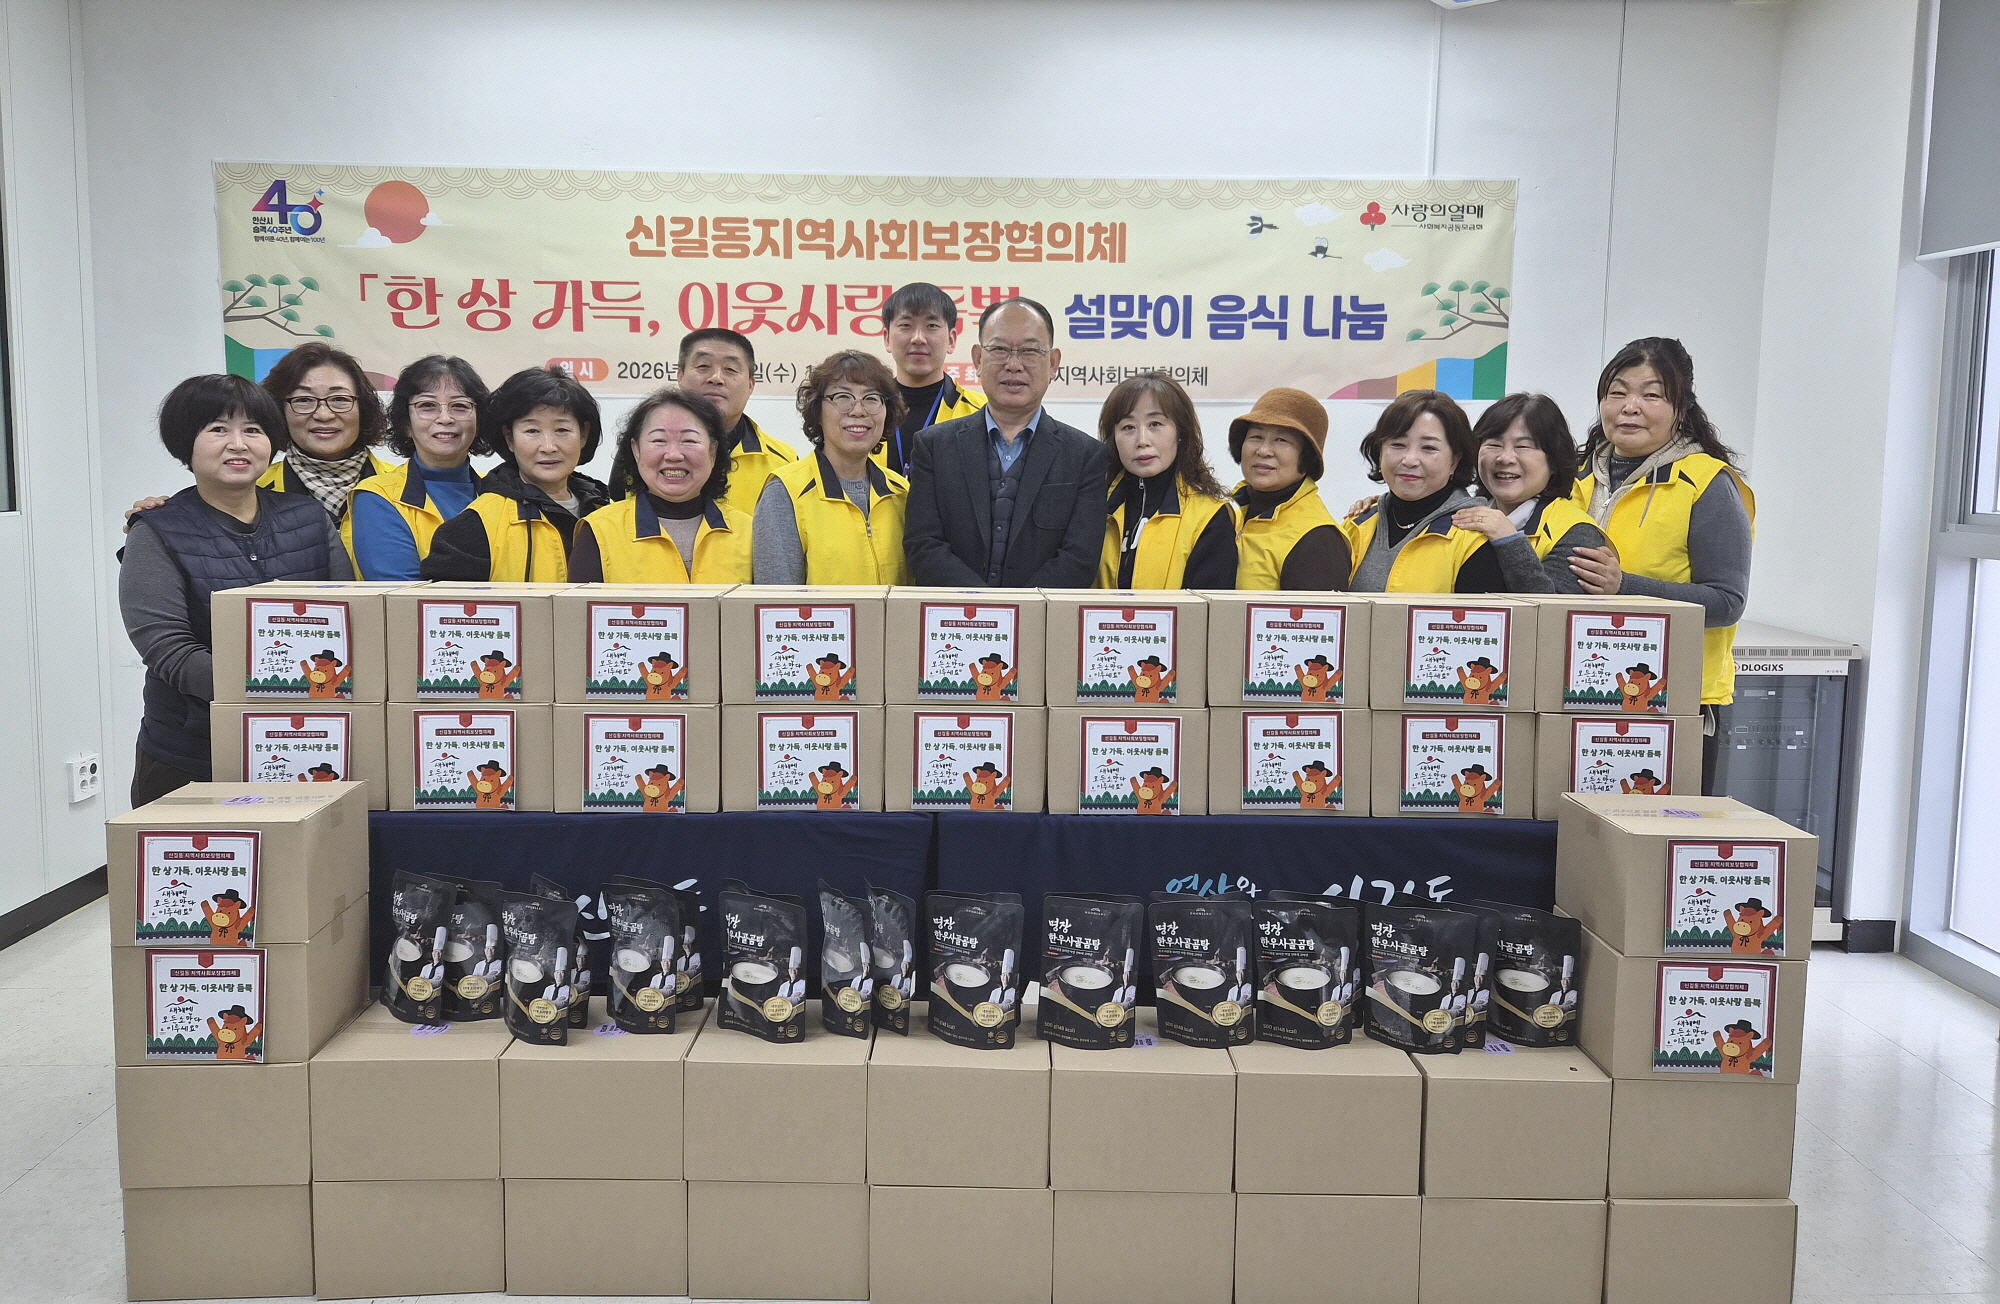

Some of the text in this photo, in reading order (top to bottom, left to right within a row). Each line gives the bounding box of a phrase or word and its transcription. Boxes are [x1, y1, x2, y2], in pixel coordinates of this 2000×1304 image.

[1391, 204, 1484, 222] 사랑의열매
[252, 216, 273, 225] 안산시
[625, 214, 1127, 264] 신길동지역사회보장협의체
[456, 278, 517, 332] 상
[531, 279, 660, 337] 가득,
[678, 281, 893, 337] 이웃사랑
[1064, 294, 1192, 340] 설맞이
[1206, 294, 1289, 341] 음식
[1302, 295, 1388, 341] 나눔
[258, 629, 266, 637] 한
[268, 629, 275, 637] 상
[430, 630, 437, 638] 한
[439, 630, 446, 638] 상
[766, 634, 773, 642] 한
[775, 634, 782, 642] 상
[931, 632, 937, 640] 한
[1090, 635, 1096, 643] 한
[1265, 634, 1272, 642] 상
[1427, 636, 1434, 644] 상
[1578, 641, 1584, 649] 한
[1741, 663, 1784, 672] DLOGIXS
[152, 866, 161, 876] 한
[163, 866, 172, 876] 상
[196, 866, 229, 876] 이웃사랑
[1680, 875, 1687, 884] 한
[1689, 876, 1697, 884] 상
[1720, 876, 1752, 885] 이웃사랑
[933, 915, 956, 930] 명장
[1048, 917, 1072, 933] 명장
[1155, 921, 1179, 935] 명장
[1259, 921, 1284, 936] 명장
[1371, 922, 1396, 938] 명장
[727, 928, 765, 947] 우사골곰탕
[934, 930, 978, 949] 한우사골곰탕
[1048, 932, 1101, 950] 한우사골곰탕
[1156, 936, 1210, 951] 한우사골곰탕
[1260, 937, 1315, 951] 한우사골곰탕
[1371, 936, 1429, 957] 한우사골곰탕
[160, 984, 168, 992] 한
[170, 984, 178, 992] 상
[201, 984, 234, 992] 이웃사랑
[1669, 996, 1677, 1004] 한
[1679, 996, 1687, 1005] 상
[1710, 997, 1742, 1006] 이웃사랑
